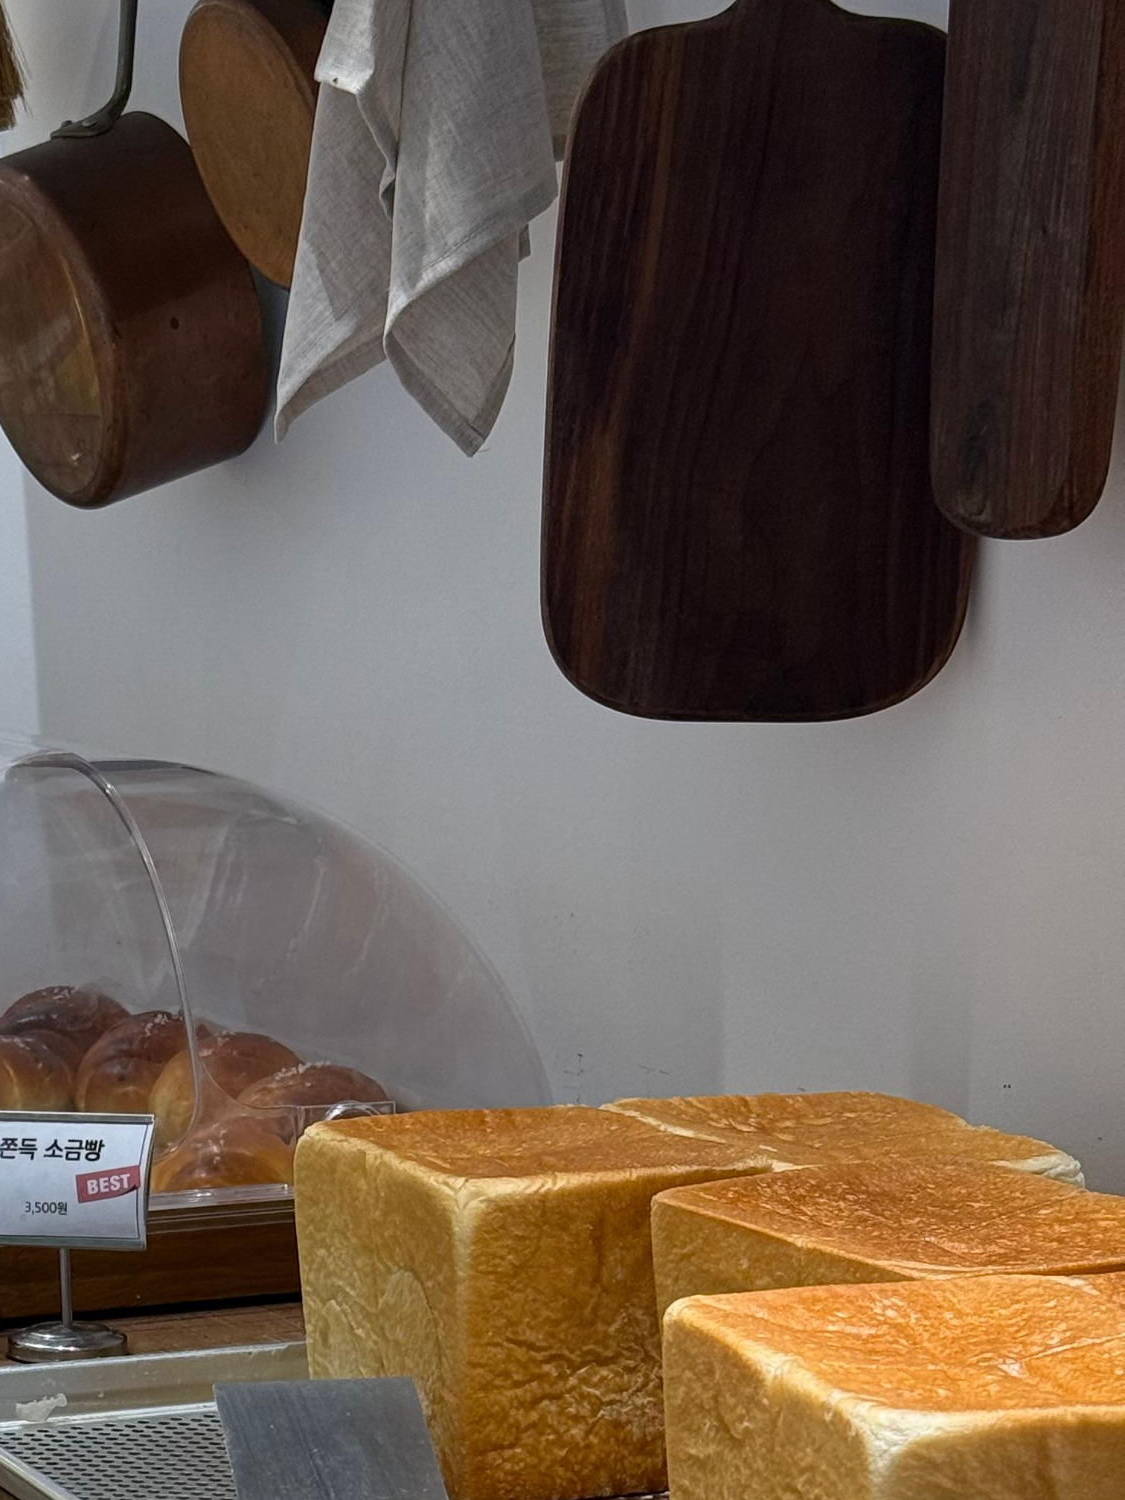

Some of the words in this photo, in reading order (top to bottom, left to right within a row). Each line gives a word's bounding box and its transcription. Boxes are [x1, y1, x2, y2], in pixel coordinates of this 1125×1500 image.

[0, 1137, 38, 1161] 쫀득
[43, 1138, 105, 1162] 소금빵
[86, 1173, 131, 1195] BEST
[24, 1201, 68, 1216] 3,500원
